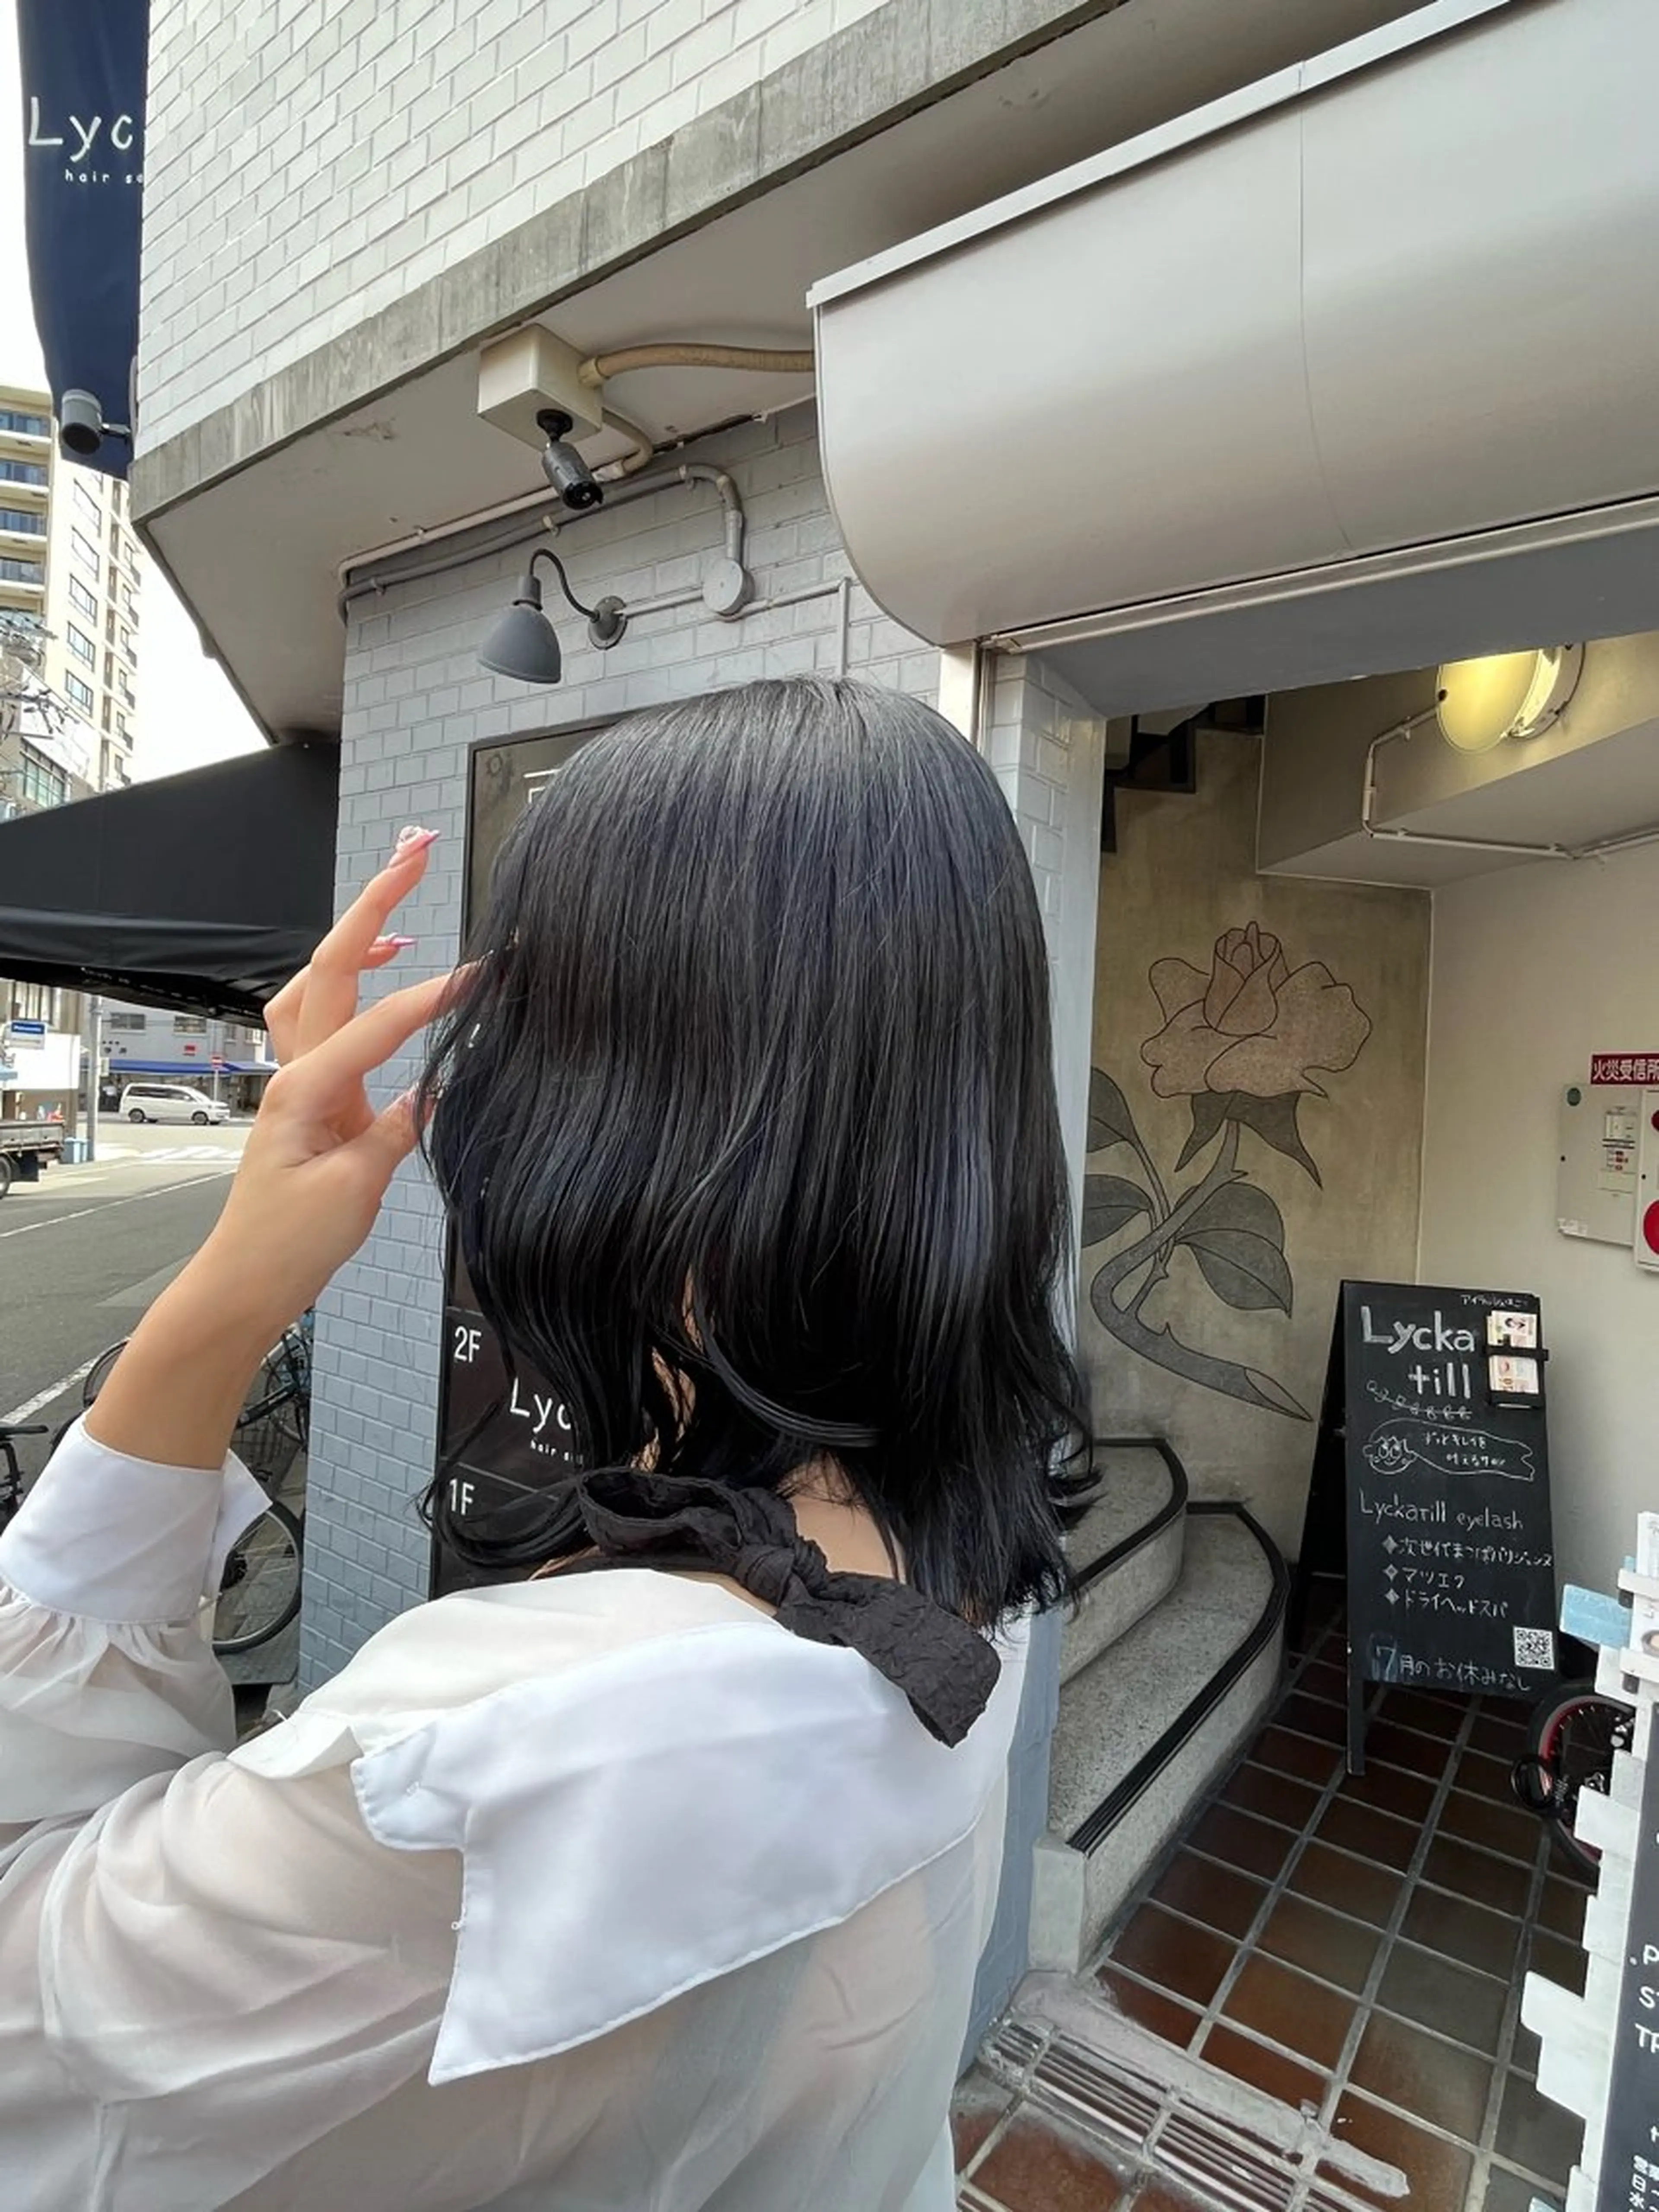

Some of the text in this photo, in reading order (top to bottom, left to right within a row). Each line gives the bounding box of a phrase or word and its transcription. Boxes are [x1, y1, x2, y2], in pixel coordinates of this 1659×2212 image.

[29, 96, 133, 162] Lyc
[65, 169, 109, 182] hair
[454, 1325, 482, 1363] 2F
[1360, 1306, 1475, 1354] Lycka
[1408, 1362, 1471, 1399] till
[449, 1478, 474, 1516] 1F
[1456, 1506, 1524, 1531] eyelash
[1402, 1567, 1465, 1589] マツエク
[1405, 1590, 1509, 1619] ドライヘッドスパ
